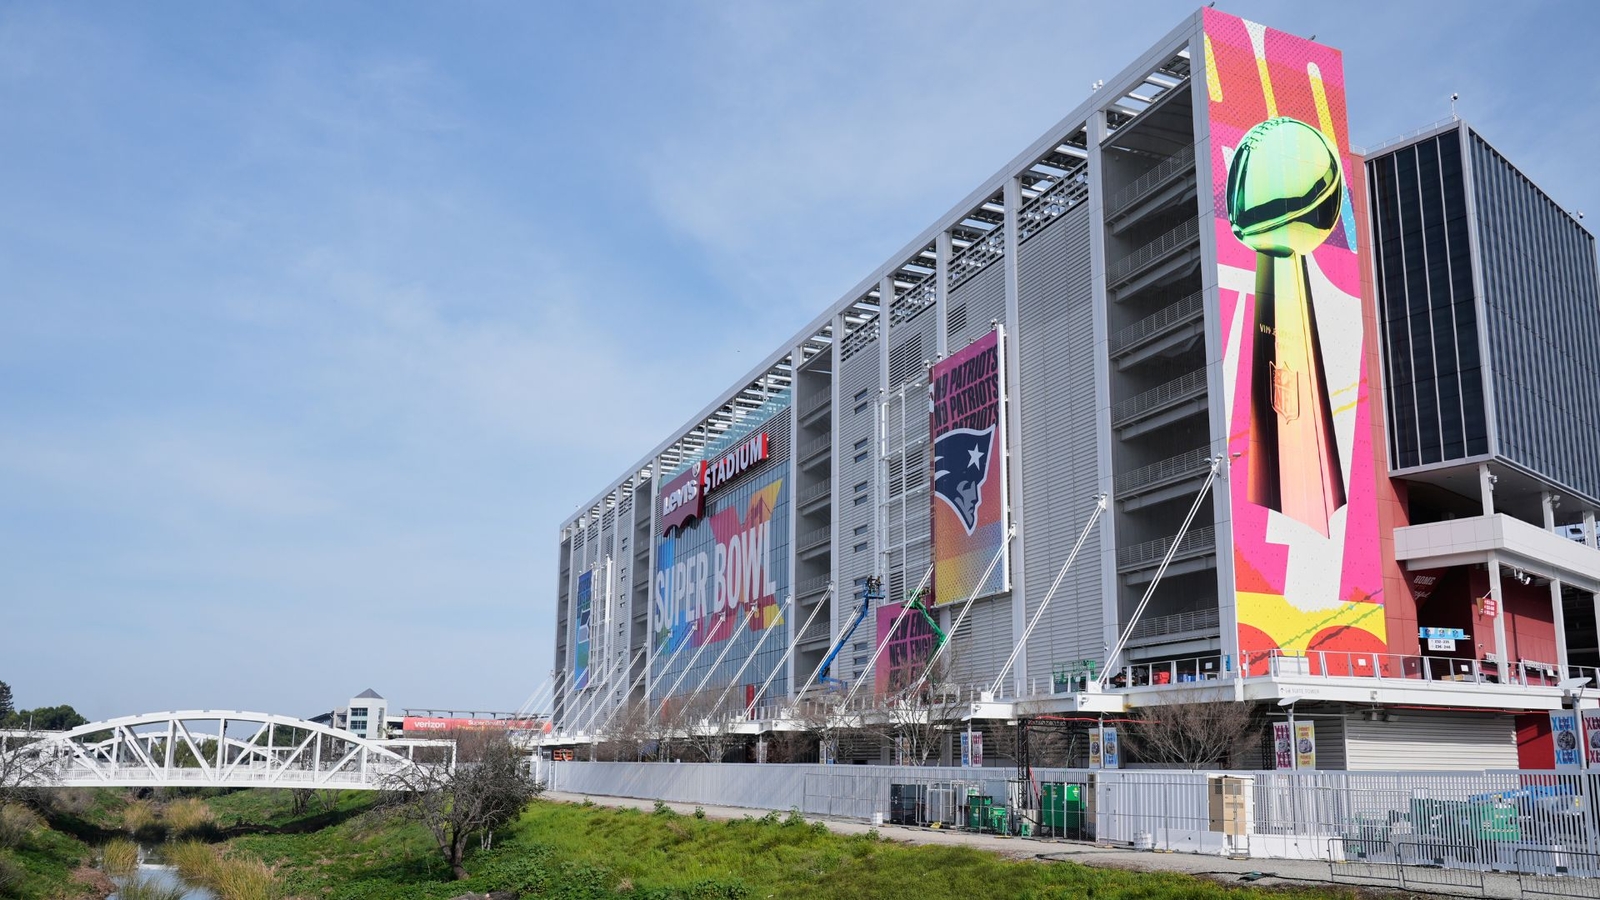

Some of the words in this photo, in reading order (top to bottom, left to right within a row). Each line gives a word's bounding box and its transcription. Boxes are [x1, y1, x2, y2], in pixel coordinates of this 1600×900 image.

[950, 344, 999, 394] PATRIOTS
[950, 373, 999, 420] PATRIOTS
[703, 433, 765, 496] STADIUM
[654, 552, 708, 633] SUPER
[714, 520, 776, 613] BOWL
[414, 720, 446, 728] verizon
